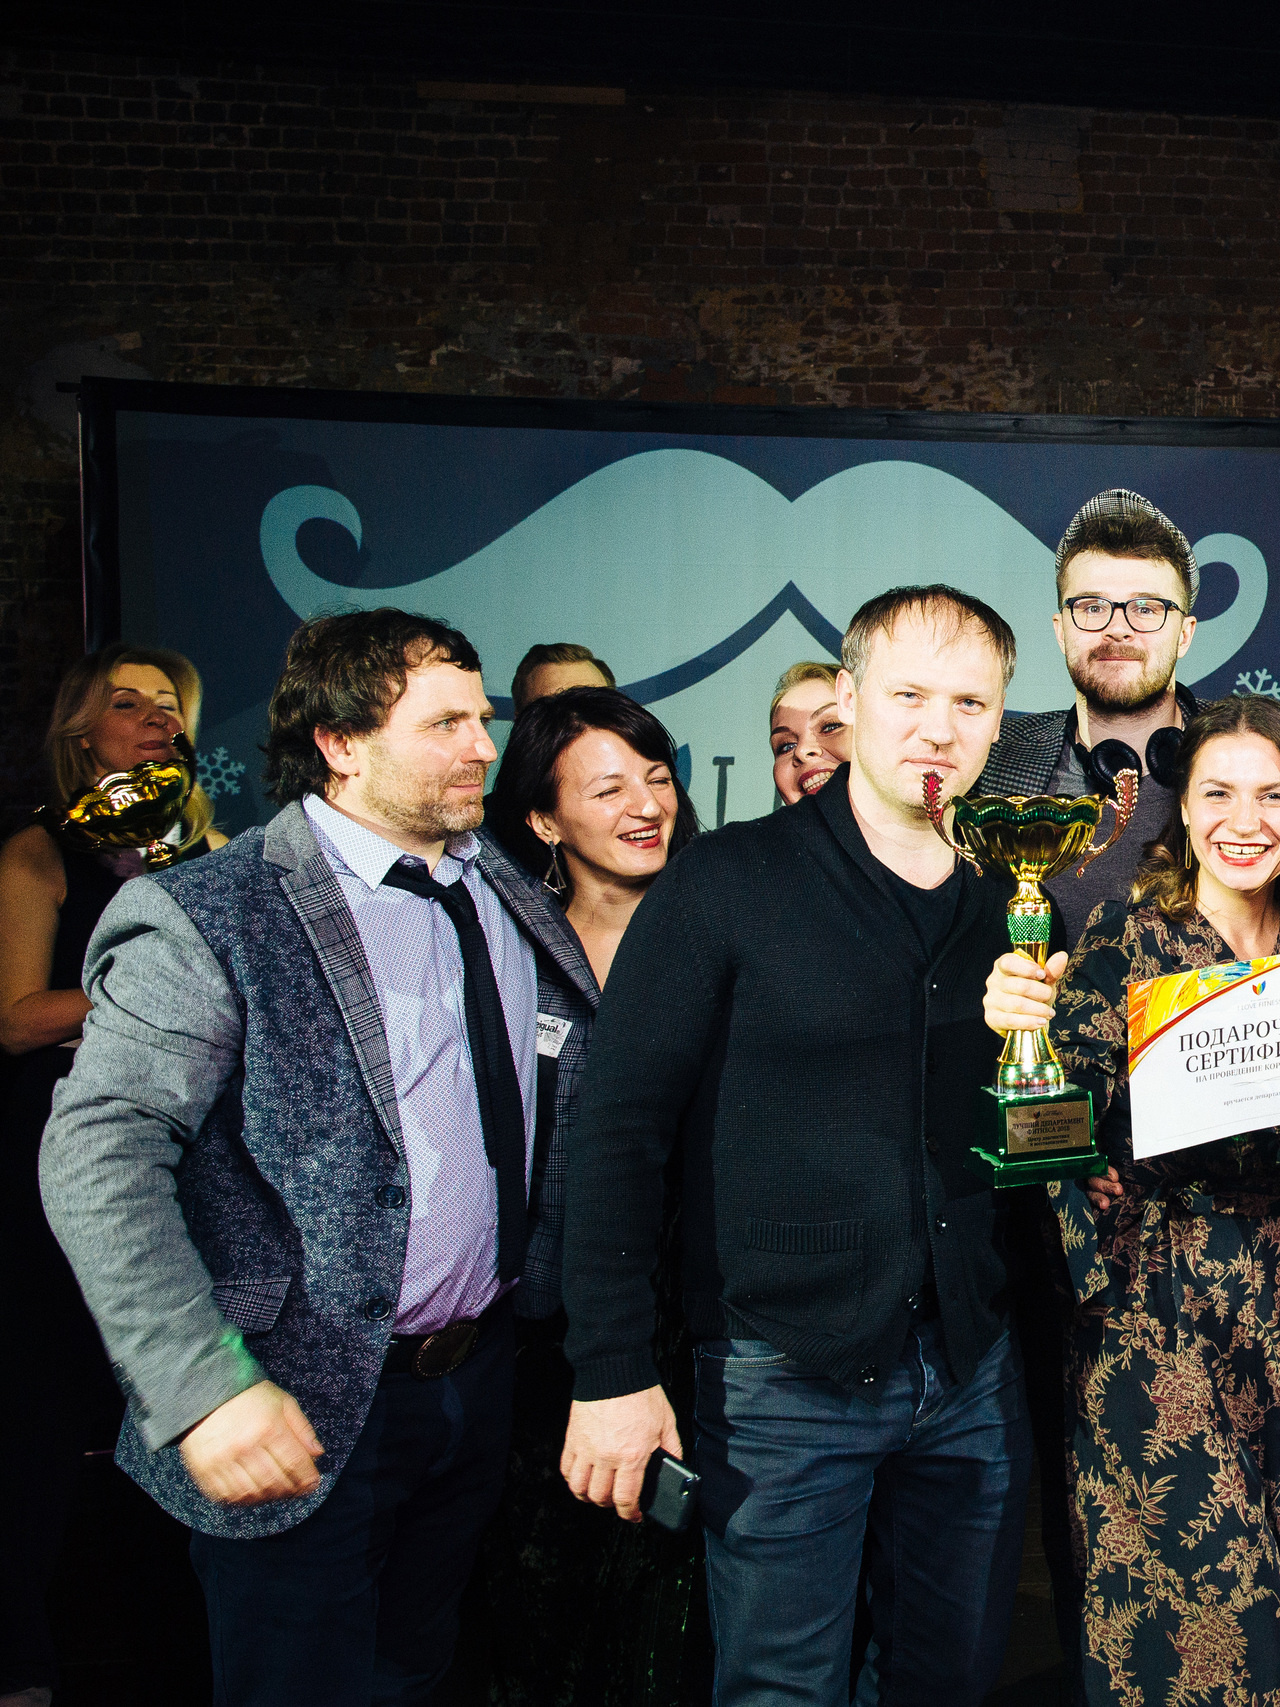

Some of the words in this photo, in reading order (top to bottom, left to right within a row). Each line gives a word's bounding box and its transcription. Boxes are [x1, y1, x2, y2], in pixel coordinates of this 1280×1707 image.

[1241, 1002, 1257, 1011] LOVE
[1195, 1074, 1208, 1083] НА
[1209, 1065, 1263, 1081] ПРОВЕДЕНИЕ
[1223, 1096, 1254, 1106] вручается
[1012, 1120, 1039, 1130] ЛУЧШИЙ
[1040, 1117, 1085, 1127] ДЕПАРТАМЕНТ
[1026, 1126, 1056, 1135] ФИТНЕСА
